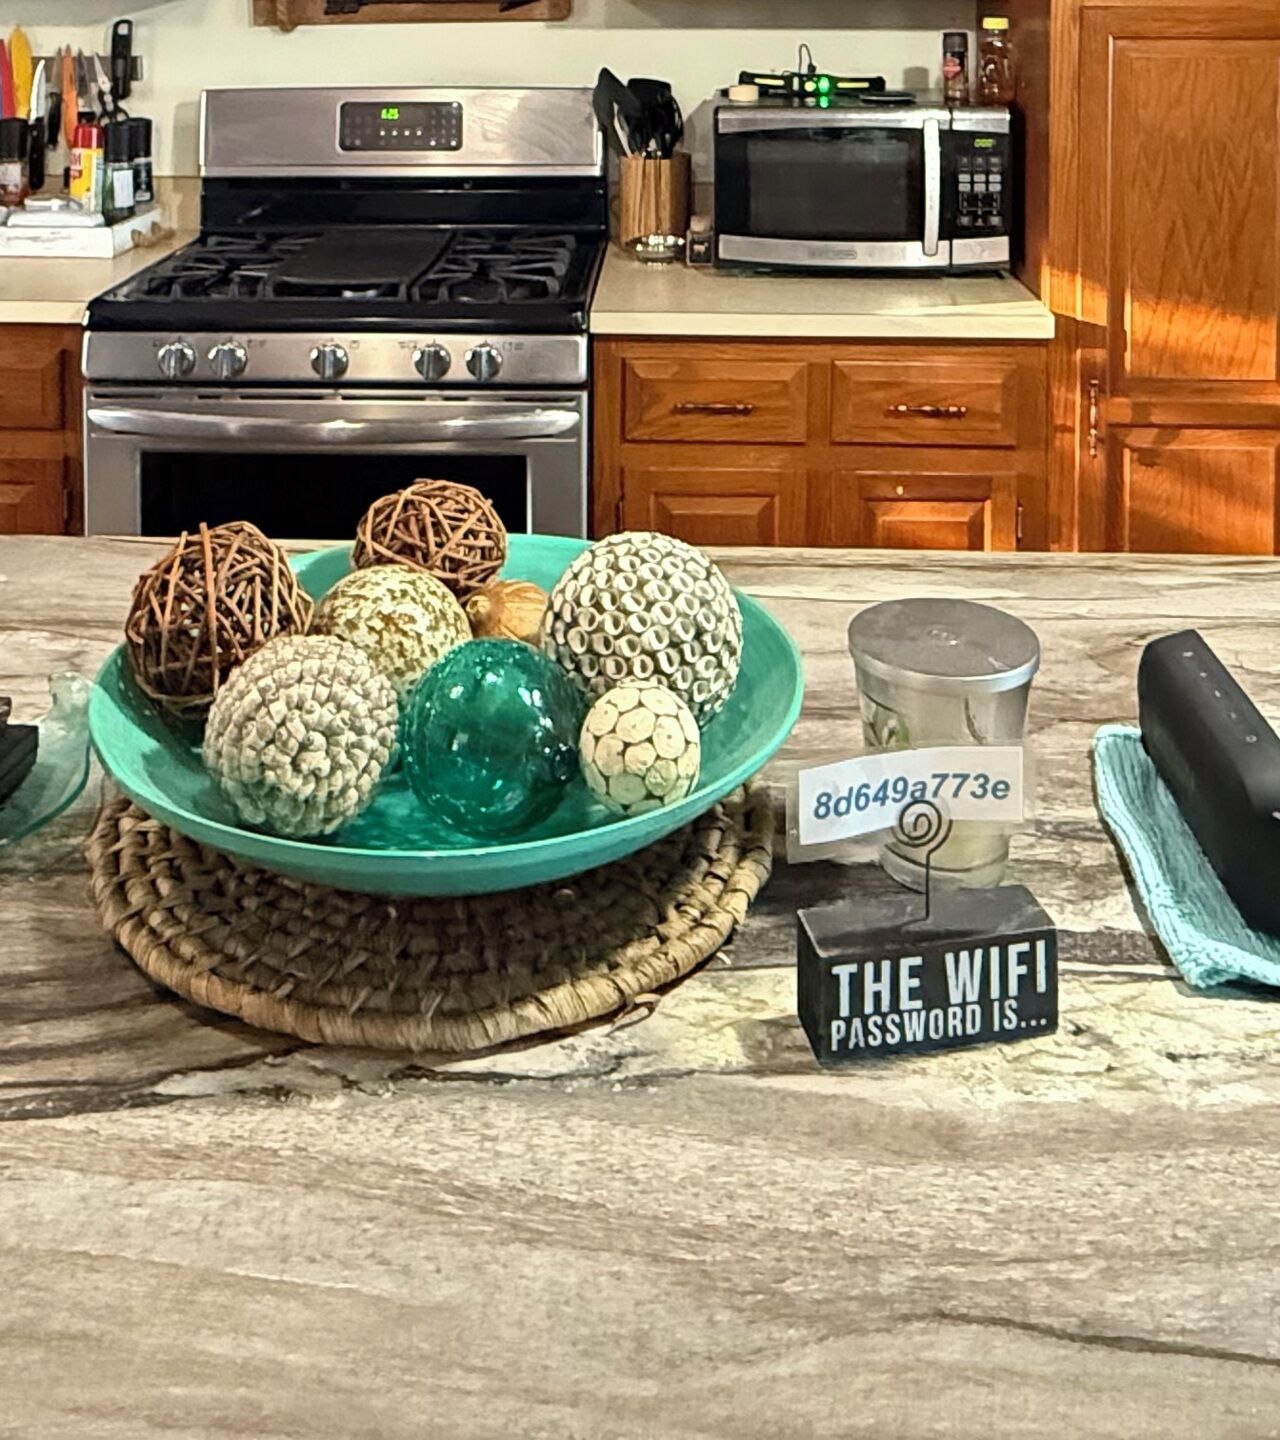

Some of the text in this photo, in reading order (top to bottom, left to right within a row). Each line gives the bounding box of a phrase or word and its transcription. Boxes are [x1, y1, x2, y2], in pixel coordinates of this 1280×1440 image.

[813, 773, 1011, 820] 8d649a773e
[831, 940, 1047, 1017] THE WIFI
[830, 998, 1048, 1051] PASSWORD IS...
